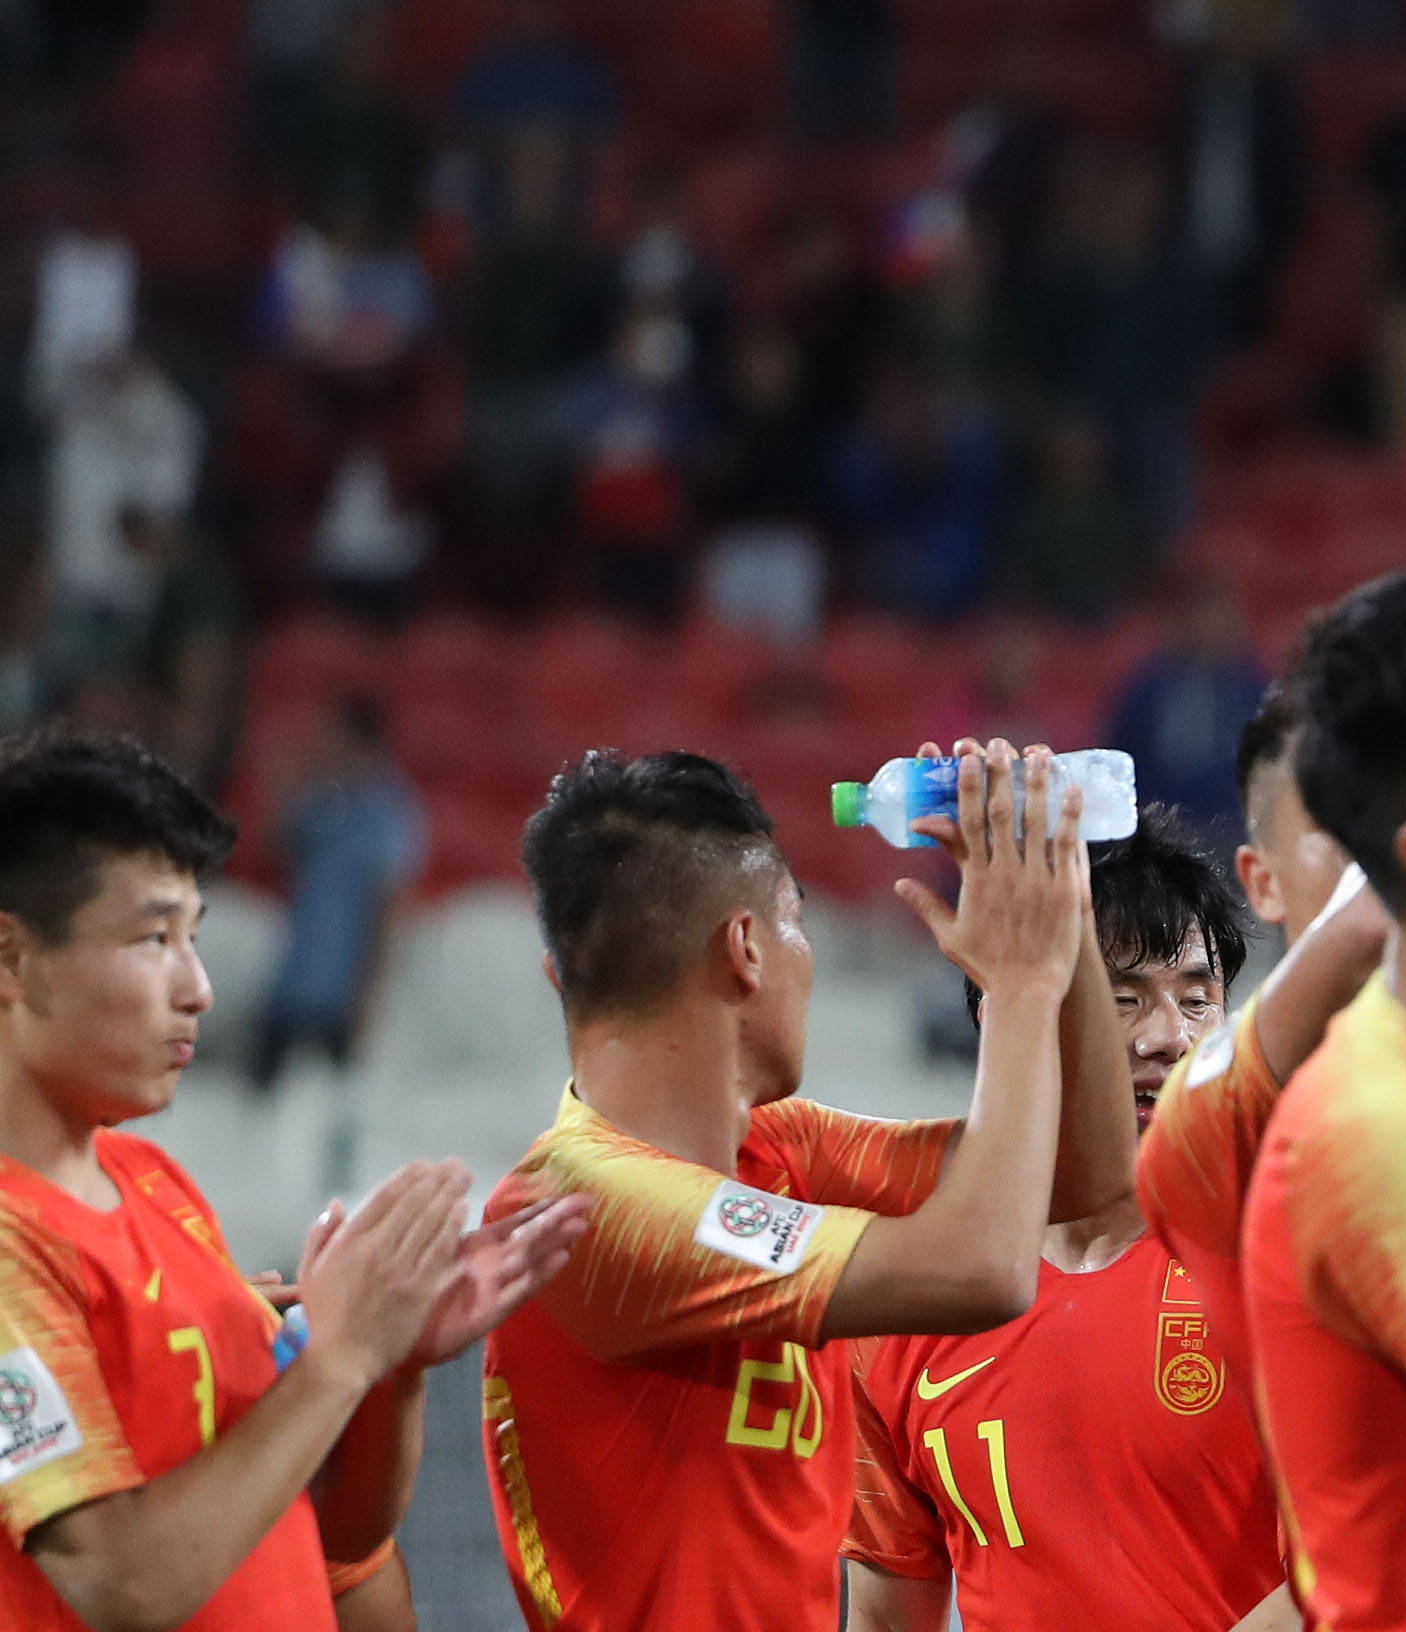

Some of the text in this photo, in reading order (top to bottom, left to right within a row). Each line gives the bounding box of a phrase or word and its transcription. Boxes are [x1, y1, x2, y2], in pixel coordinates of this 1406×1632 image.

[167, 1326, 216, 1446] 7
[725, 1341, 823, 1459] 20
[922, 1419, 1024, 1549] 11
